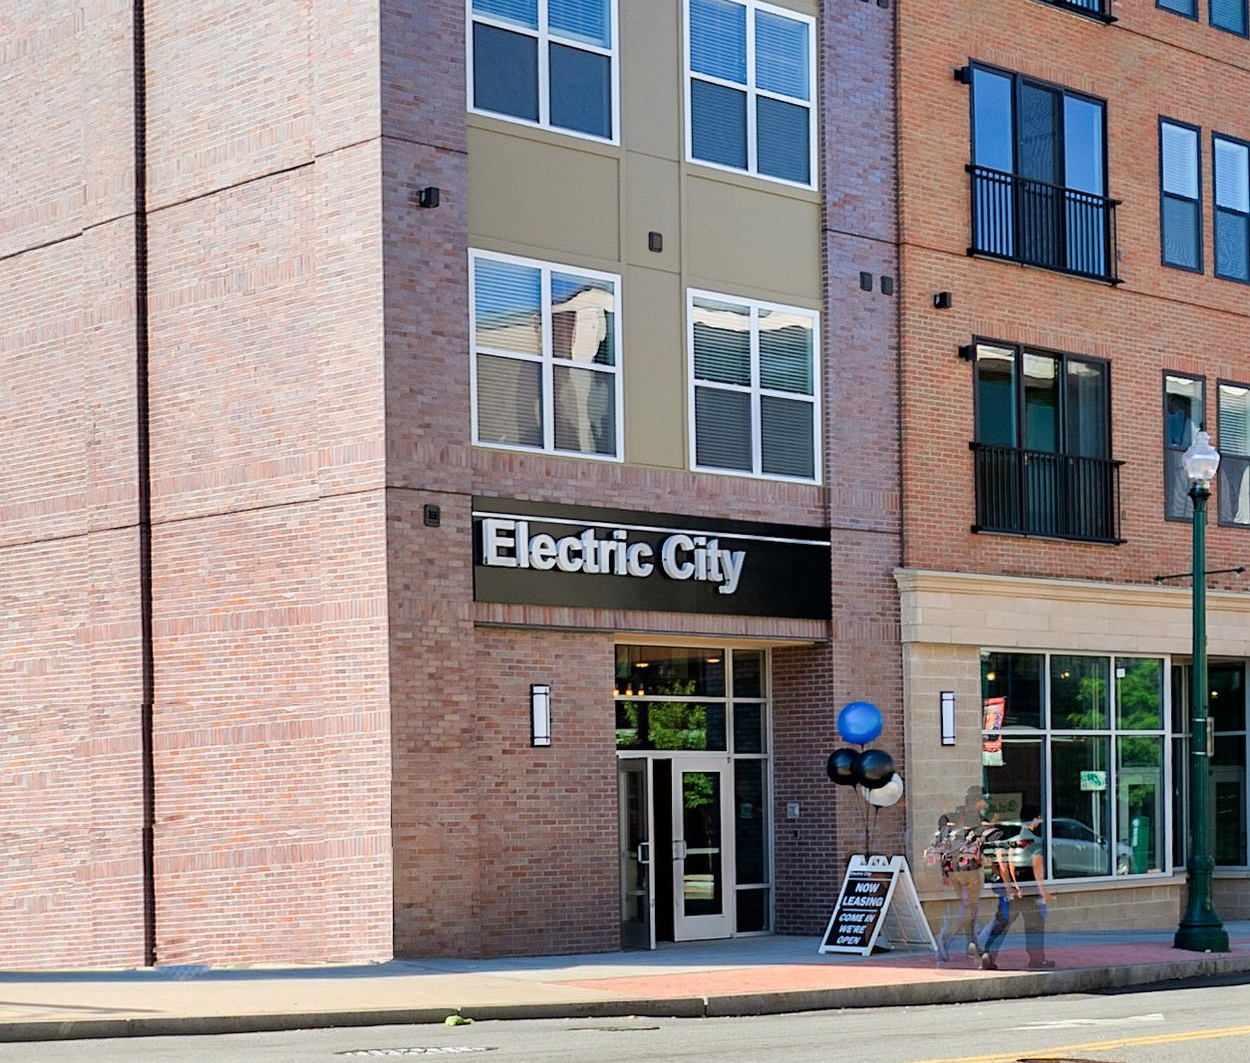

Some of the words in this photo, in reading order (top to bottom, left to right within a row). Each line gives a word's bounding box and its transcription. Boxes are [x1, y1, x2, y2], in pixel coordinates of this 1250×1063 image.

[482, 518, 654, 578] Electric
[661, 534, 746, 595] City
[855, 882, 880, 893] NOW
[842, 896, 884, 907] LEASING
[838, 913, 864, 923] COME
[864, 914, 876, 923] IN
[836, 936, 861, 945] OPEN
